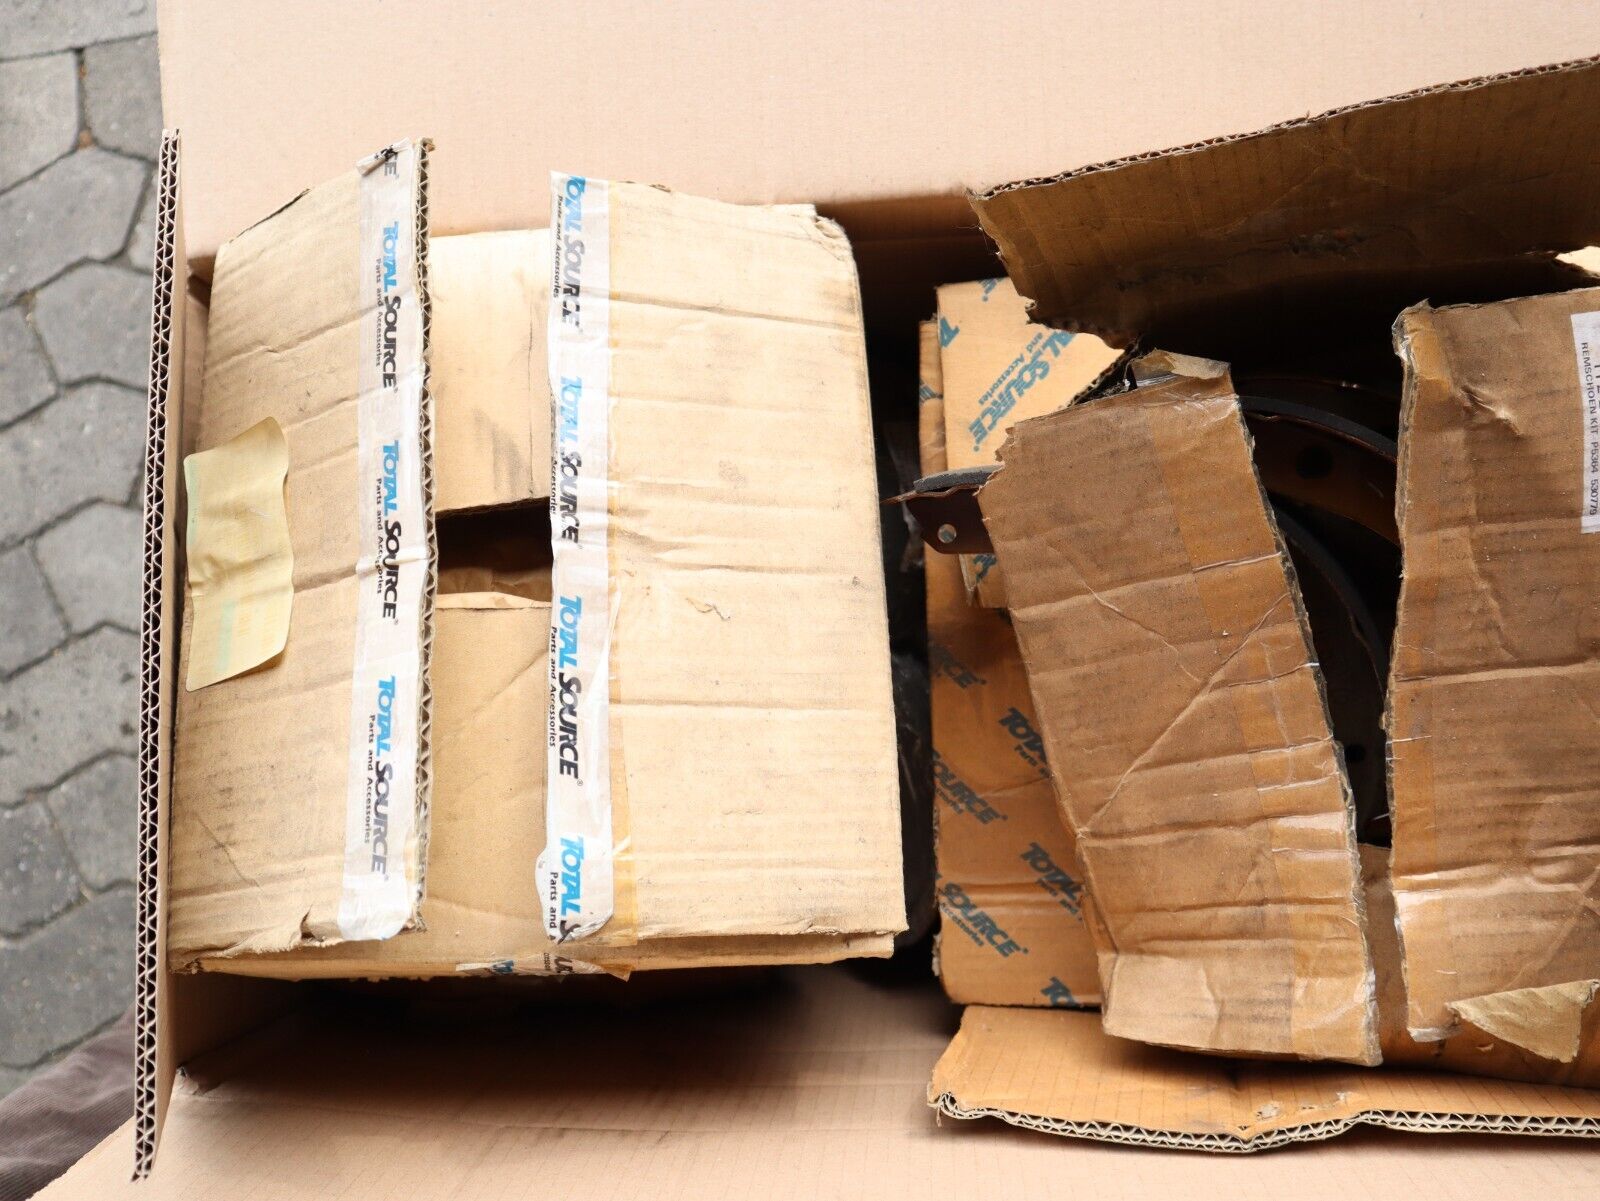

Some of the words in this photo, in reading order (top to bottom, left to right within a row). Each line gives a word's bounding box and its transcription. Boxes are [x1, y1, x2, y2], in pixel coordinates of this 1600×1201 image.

[383, 221, 399, 293] TOTAL
[553, 244, 562, 298] Accessories
[375, 311, 384, 367] Accessories
[383, 295, 401, 389] SOURCE
[559, 376, 582, 443] TOTAL
[968, 350, 1051, 444] SOURCE
[1581, 342, 1597, 415] REMSCHOEN
[1590, 417, 1599, 435] KIT
[383, 440, 399, 516] TOTAL
[559, 446, 582, 543] SOURCE
[375, 536, 384, 594] Accessories
[382, 519, 402, 619] SOURCE
[559, 596, 582, 669] TOTAL
[368, 714, 376, 744] Parts
[376, 675, 396, 757] TOTAL
[549, 683, 557, 747] Accessories
[558, 672, 582, 779] SOURCE
[364, 777, 373, 844] Accessories
[371, 760, 393, 876] SOURCE
[549, 872, 559, 902] Parts
[560, 834, 584, 917] TOTAL
[549, 907, 557, 929] and
